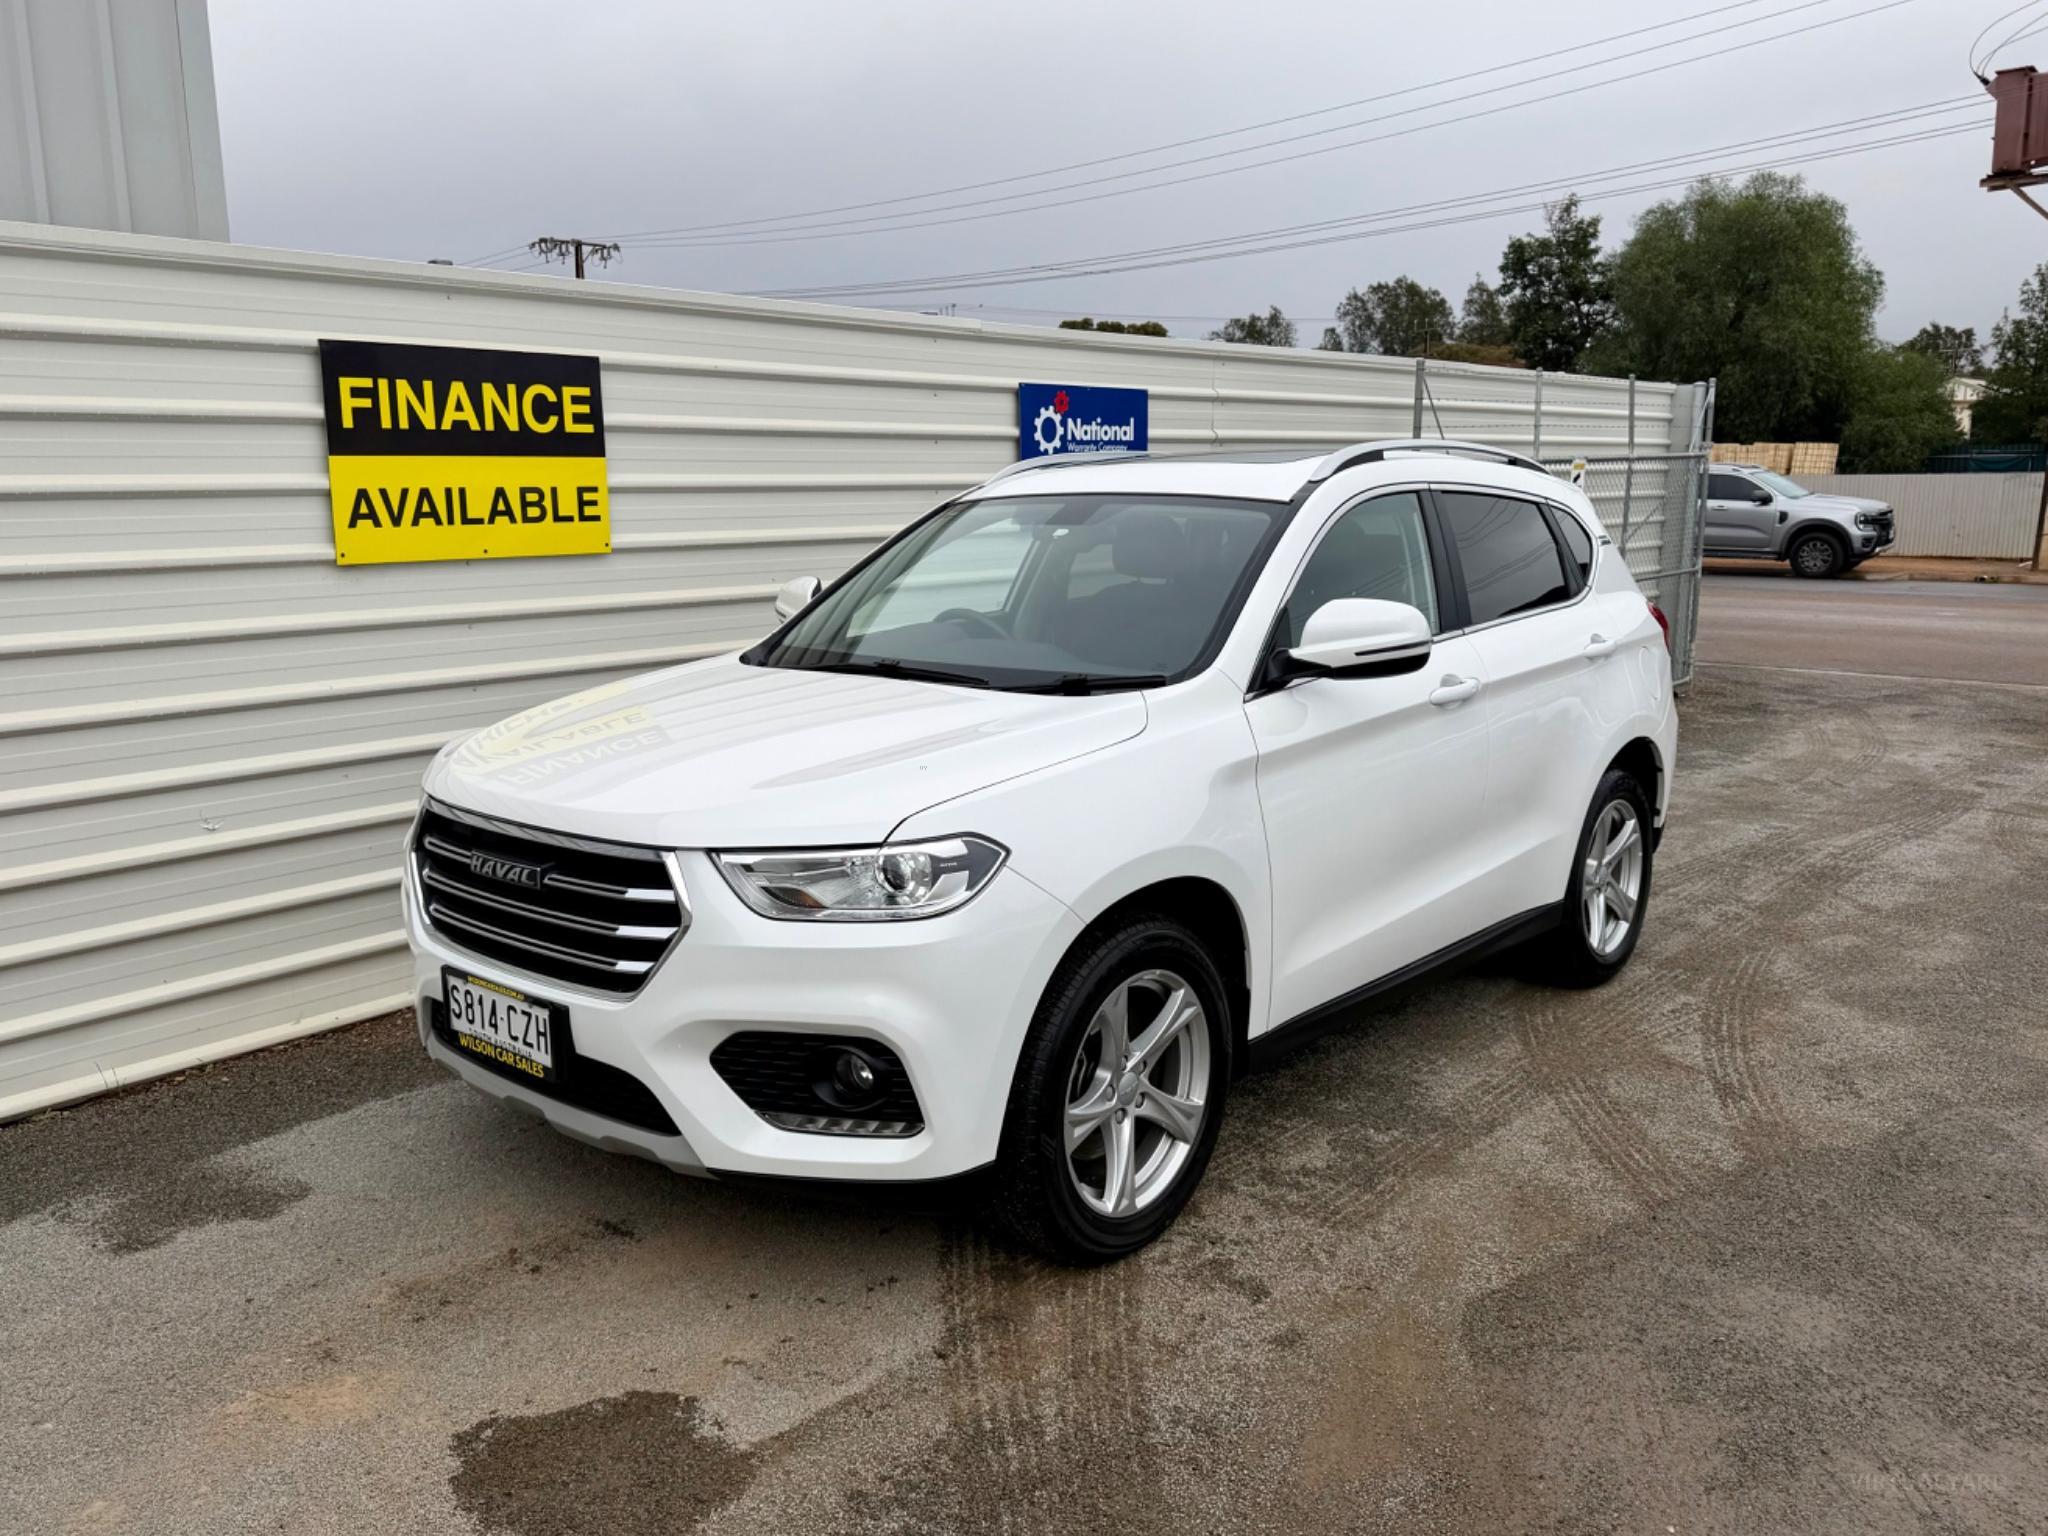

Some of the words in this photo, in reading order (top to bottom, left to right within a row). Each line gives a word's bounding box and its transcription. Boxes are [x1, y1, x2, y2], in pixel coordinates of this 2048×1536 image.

[338, 377, 595, 433] FINANCE
[1066, 416, 1135, 441] National
[348, 486, 602, 528] AVAILABLE
[471, 855, 536, 885] HAVAL
[459, 1032, 495, 1059] WILSON
[496, 1048, 514, 1066] CAR
[516, 1056, 544, 1077] SALES
